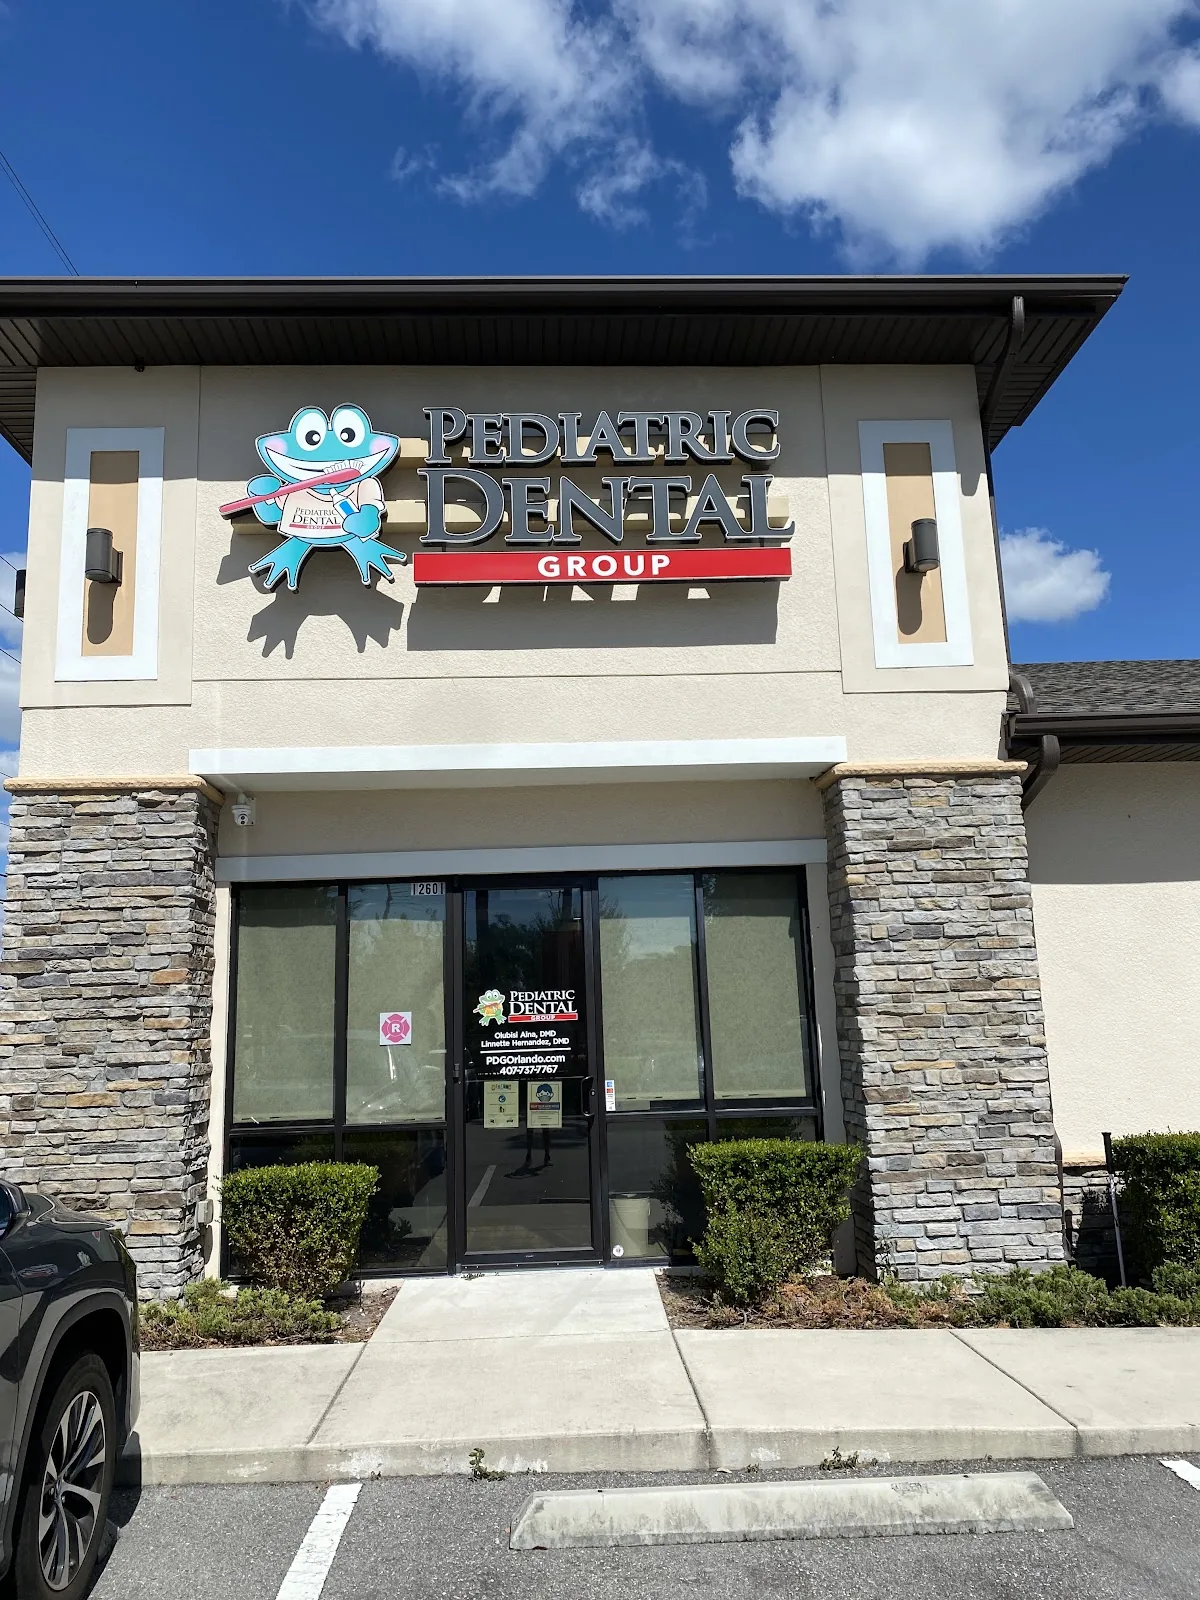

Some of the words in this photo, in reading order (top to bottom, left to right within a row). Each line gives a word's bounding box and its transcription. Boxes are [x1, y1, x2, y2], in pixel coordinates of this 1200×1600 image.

[422, 406, 781, 464] PEDIATRIC
[295, 507, 338, 515] PEDIATRIC
[416, 467, 796, 544] DENTAL
[292, 514, 341, 525] DENTAL
[537, 554, 671, 578] GROUP
[413, 883, 444, 895] 12601
[510, 990, 575, 1001] PEDIATRIC
[509, 1001, 577, 1015] DENTAL
[391, 1023, 401, 1033] R
[494, 1031, 518, 1039] Olubisi
[512, 1038, 551, 1046] Hernandez,
[486, 1054, 566, 1065] PDGOrlando.com
[500, 1065, 558, 1075] 407-737-7767
